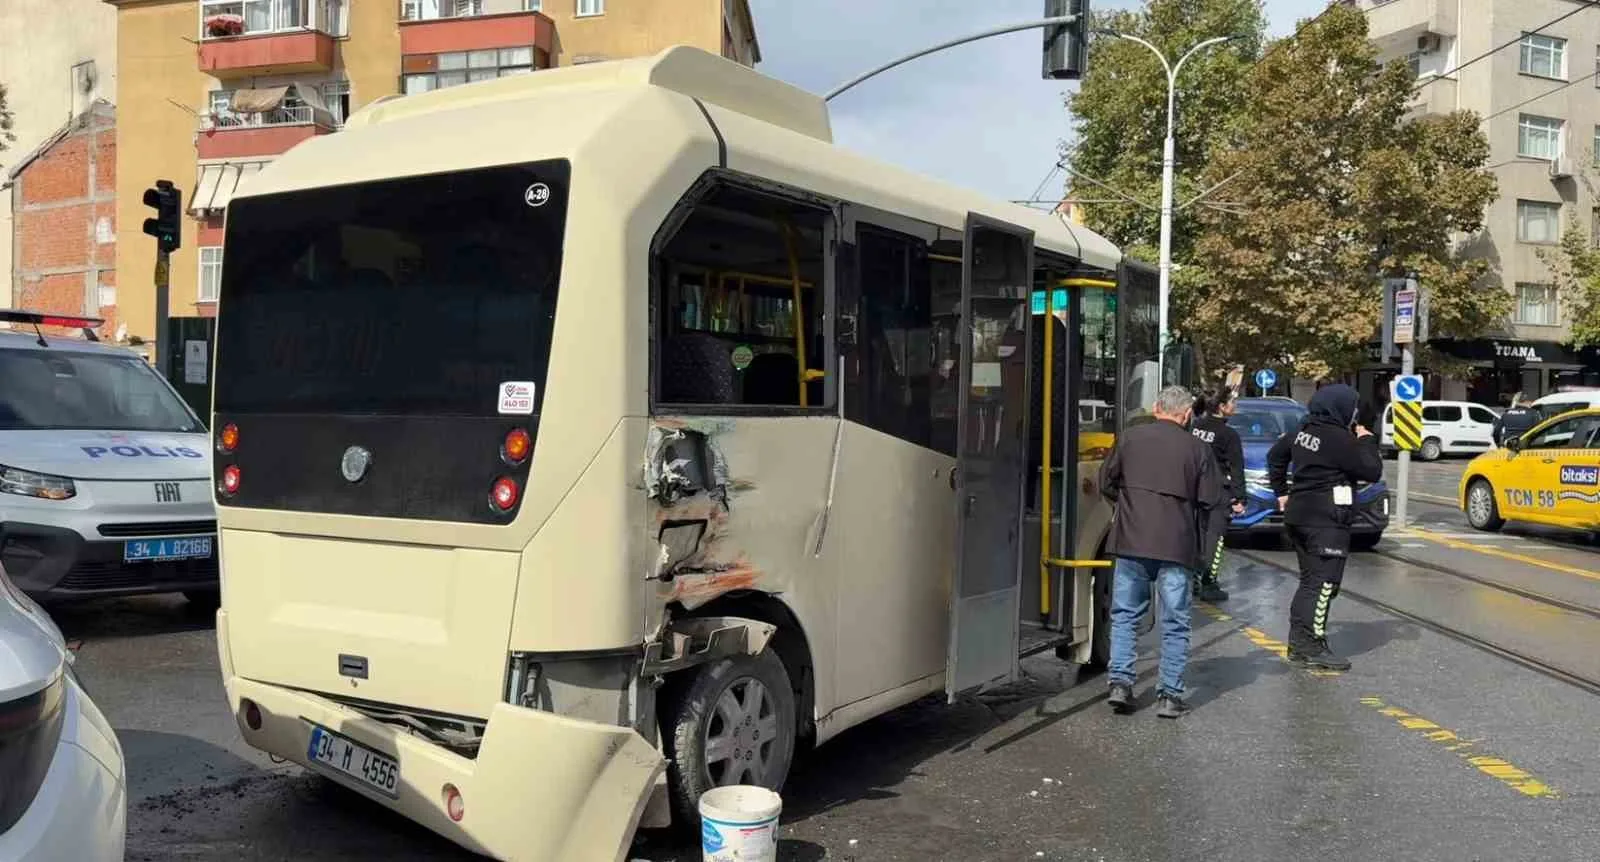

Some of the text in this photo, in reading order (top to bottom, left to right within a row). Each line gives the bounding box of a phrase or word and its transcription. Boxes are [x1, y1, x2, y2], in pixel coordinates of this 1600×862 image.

[528, 188, 547, 200] A-28
[1495, 345, 1536, 357] TUANA
[1561, 467, 1598, 483] bitaksi
[154, 483, 181, 502] FIAT
[1504, 488, 1533, 506] TCN
[1538, 490, 1555, 508] 58
[134, 538, 209, 556] 34 A 82166
[318, 735, 335, 761] 34
[362, 754, 397, 789] 4556
